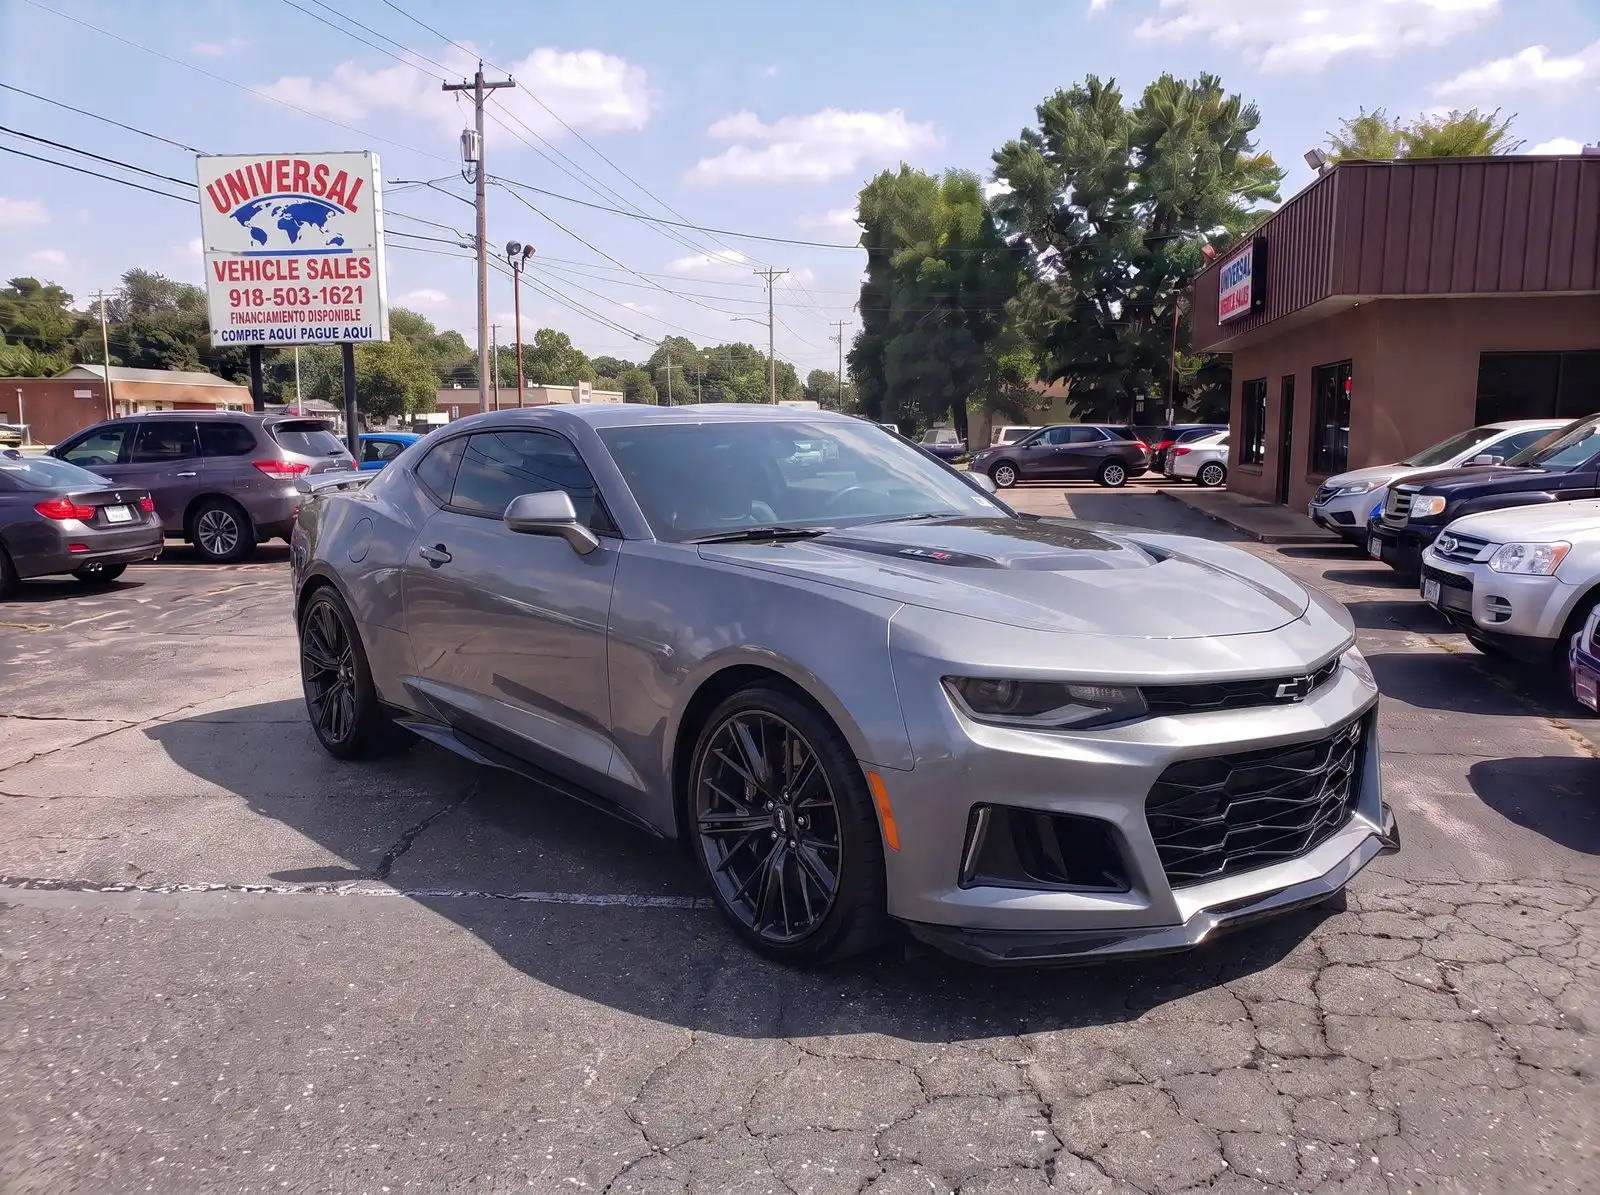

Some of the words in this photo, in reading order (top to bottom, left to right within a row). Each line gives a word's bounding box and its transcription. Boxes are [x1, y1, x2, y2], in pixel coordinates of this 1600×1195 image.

[205, 159, 364, 214] UNIVERSAL
[213, 259, 300, 282] VEHICLE
[306, 257, 372, 280] SALES
[229, 285, 363, 307] 918-503-1621
[230, 310, 306, 325] FINANCIAMIENTO
[308, 308, 362, 323] DISPONIBLE
[221, 328, 265, 342] COMPRE
[300, 326, 339, 340] PAGUE
